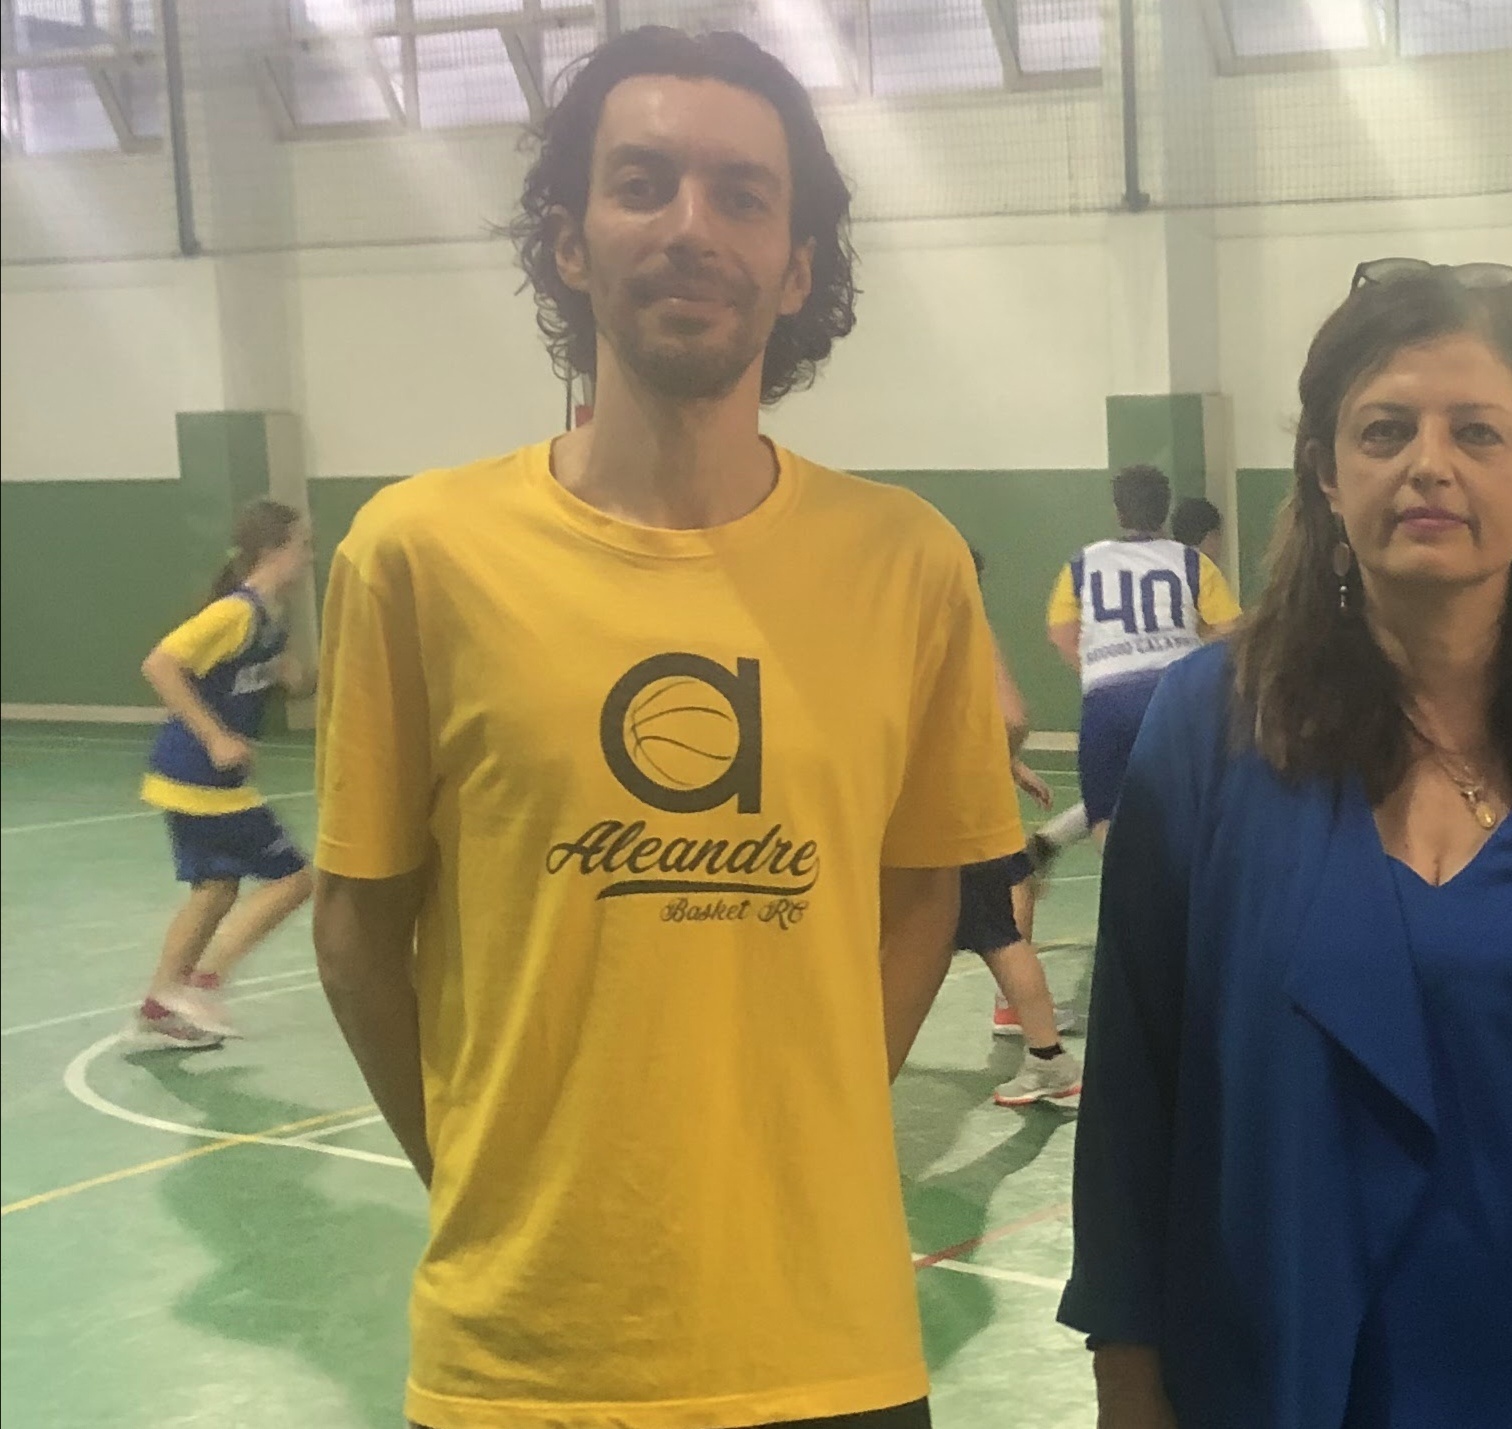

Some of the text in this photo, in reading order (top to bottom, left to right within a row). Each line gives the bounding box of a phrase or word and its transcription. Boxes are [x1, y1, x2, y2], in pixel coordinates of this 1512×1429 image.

[1090, 568, 1184, 633] 40
[546, 820, 820, 875] Aleandre
[660, 898, 749, 922] Basket
